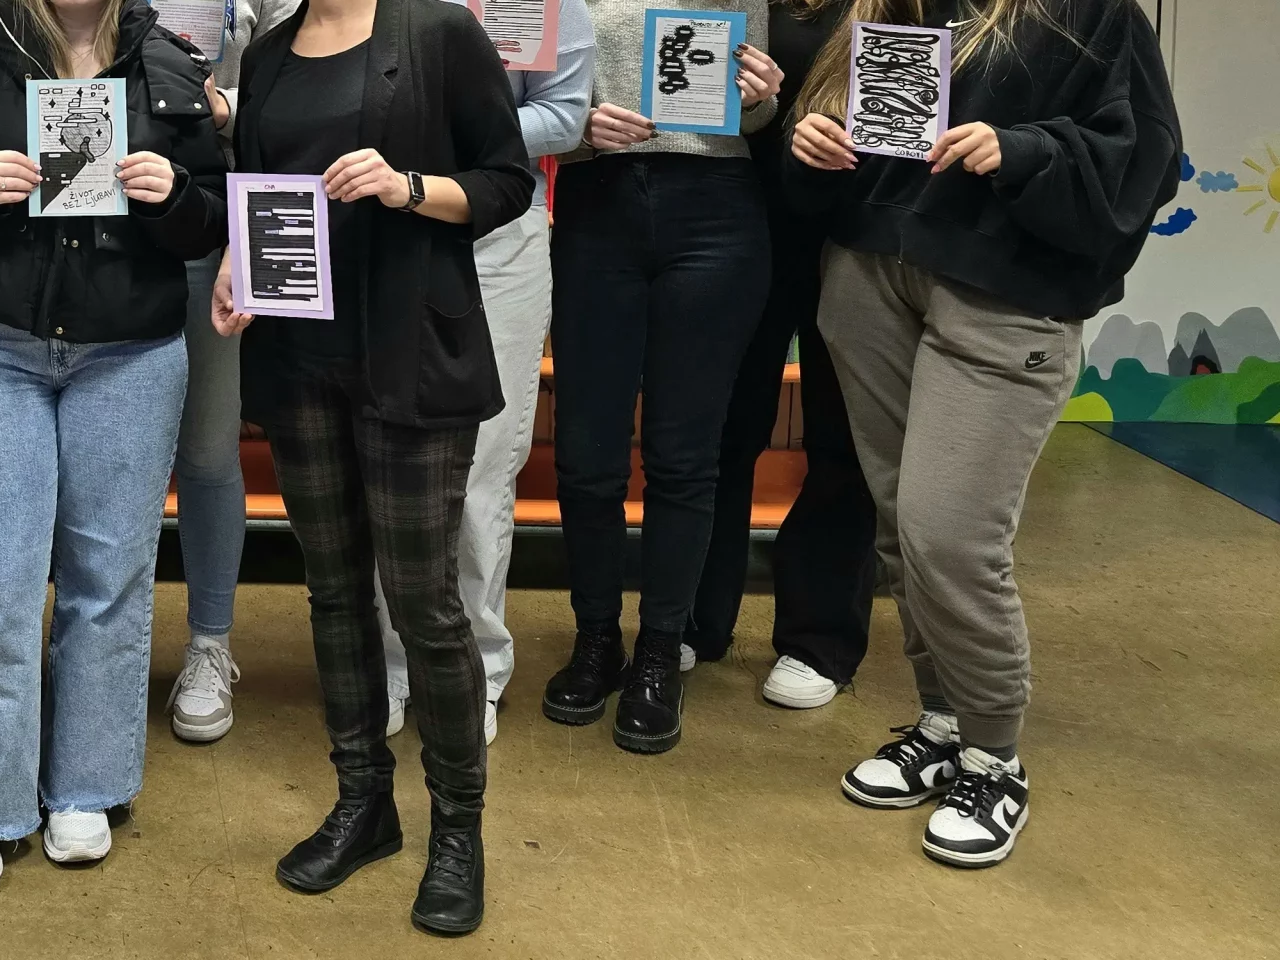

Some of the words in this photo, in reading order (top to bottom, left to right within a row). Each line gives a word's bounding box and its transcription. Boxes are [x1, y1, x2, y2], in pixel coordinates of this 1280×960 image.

[62, 199, 82, 210] BEZ
[85, 189, 117, 208] LJUBAVI
[69, 189, 95, 200] ŽIVOT
[1028, 351, 1047, 362] NIKE
